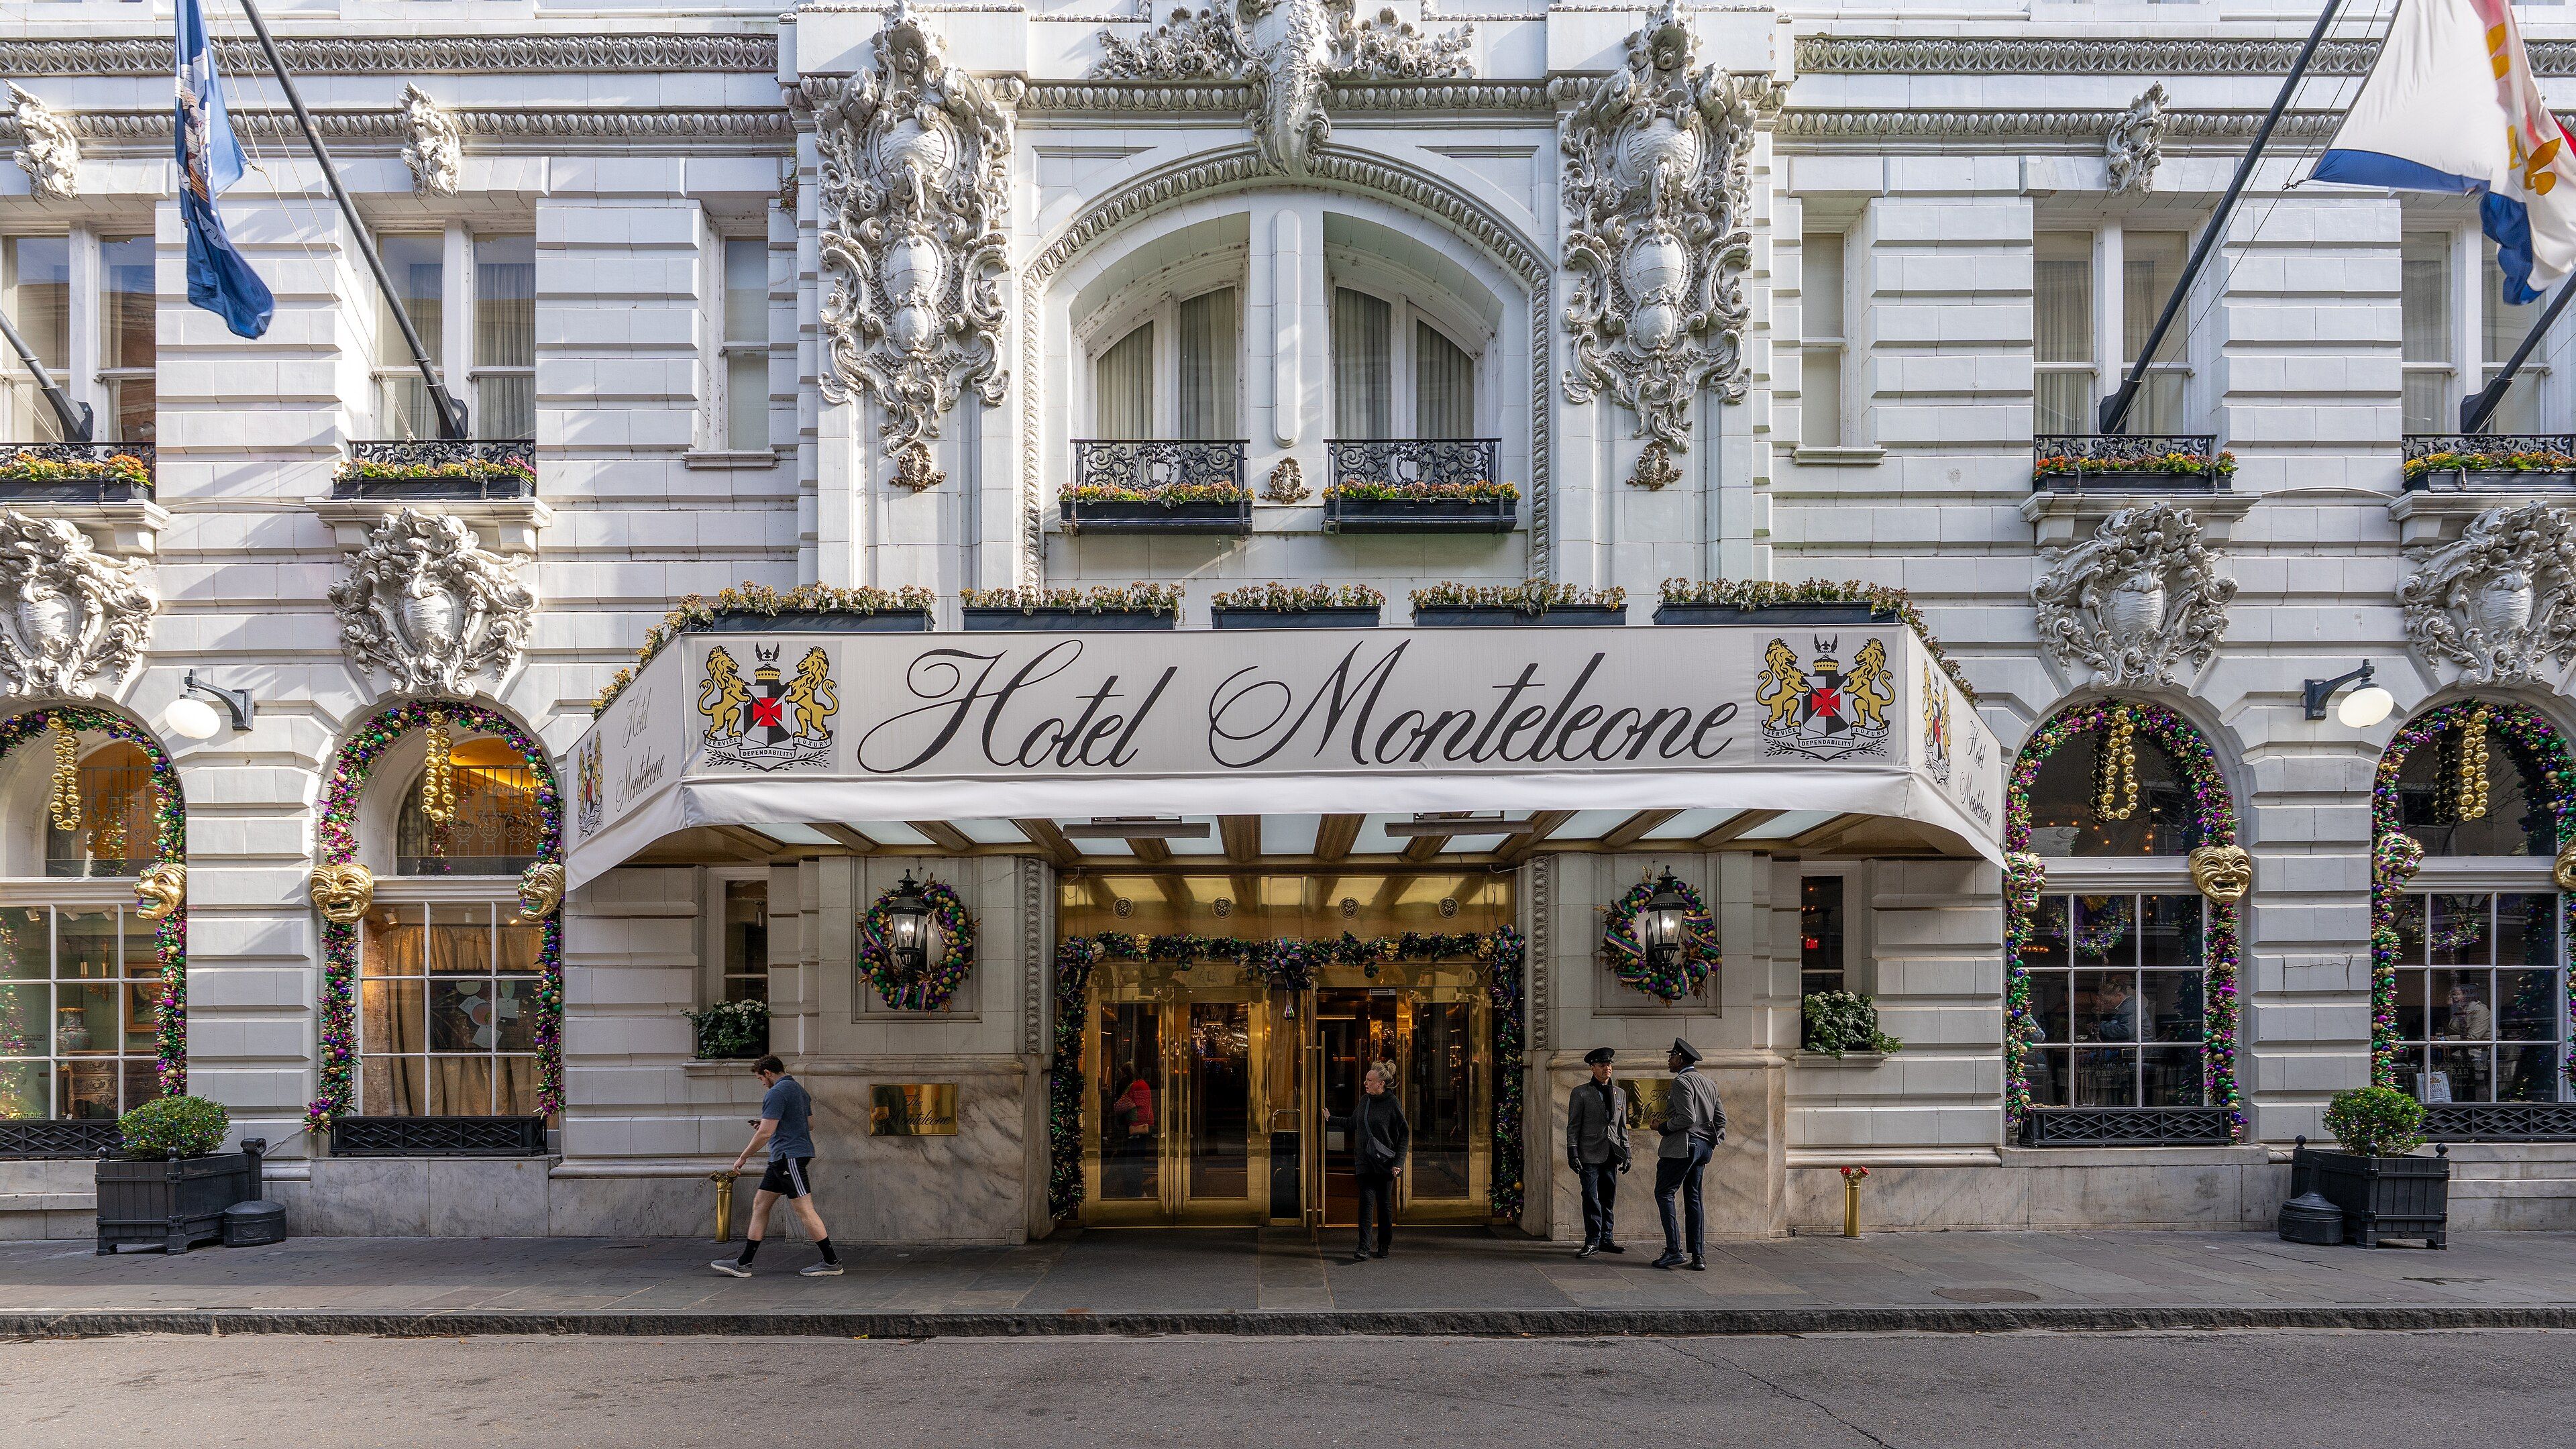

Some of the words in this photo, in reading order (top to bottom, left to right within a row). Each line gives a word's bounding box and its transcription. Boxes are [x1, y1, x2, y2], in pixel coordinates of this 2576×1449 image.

[622, 686, 651, 748] Hotel
[857, 639, 1178, 773] Hotel
[1208, 638, 1739, 768] Monteleone
[708, 738, 738, 747] SERVICE
[797, 738, 828, 747] LUXURY
[1766, 727, 1796, 737] SERVICE
[1855, 727, 1886, 737] LUXURY
[1966, 720, 1986, 770] Hotel
[743, 749, 794, 757] DEPENDABILITY
[616, 745, 665, 812] Monteleone
[1960, 771, 1992, 828] Monteleone
[875, 1107, 951, 1126] Monteleone
[904, 1094, 924, 1107] The
